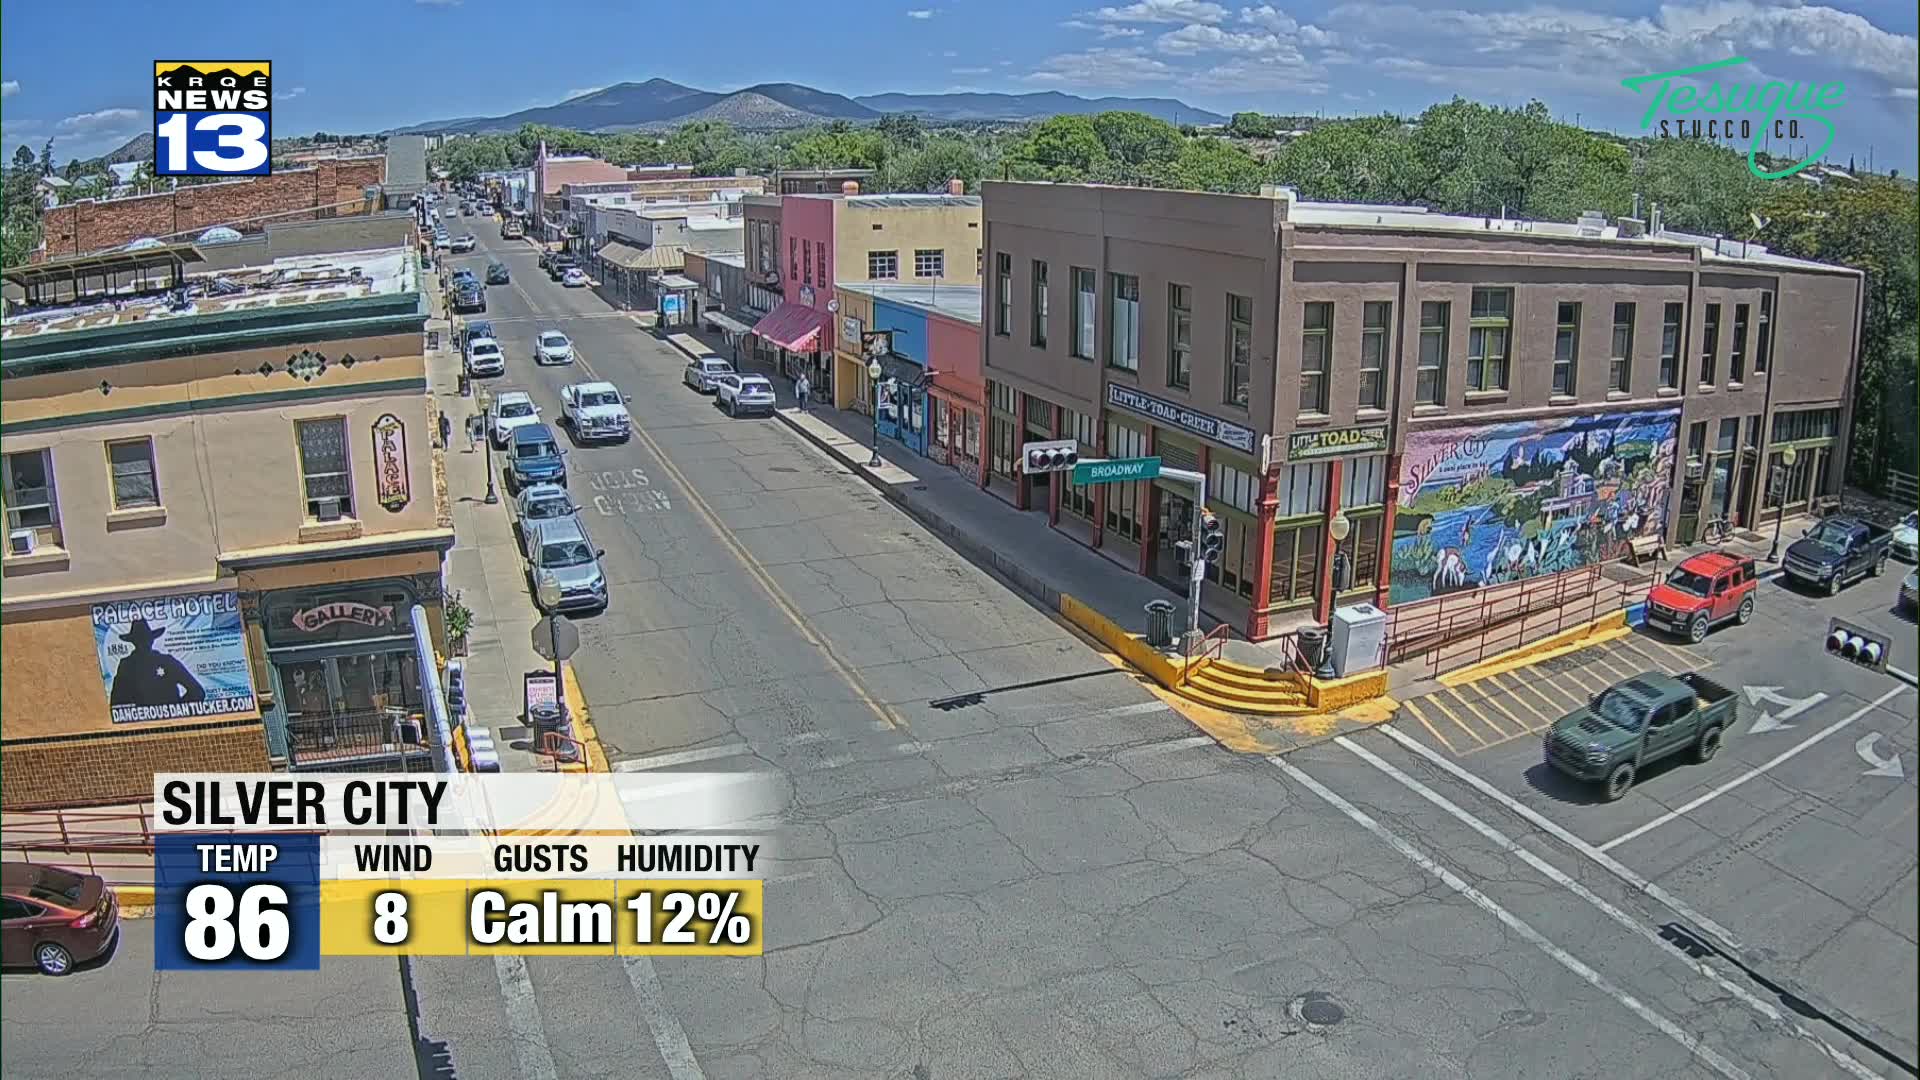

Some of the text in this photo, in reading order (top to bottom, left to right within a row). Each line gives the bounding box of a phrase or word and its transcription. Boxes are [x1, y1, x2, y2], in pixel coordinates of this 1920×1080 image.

[1113, 388, 1215, 434] LITTLE TOAD CREEK
[1320, 429, 1360, 446] TOAD
[381, 429, 400, 497] PALACE
[1091, 463, 1144, 478] BROADWAY
[1404, 434, 1494, 496] SILVER CITY
[92, 593, 238, 625] PALACE HOTEL
[303, 605, 385, 628] GALLERY
